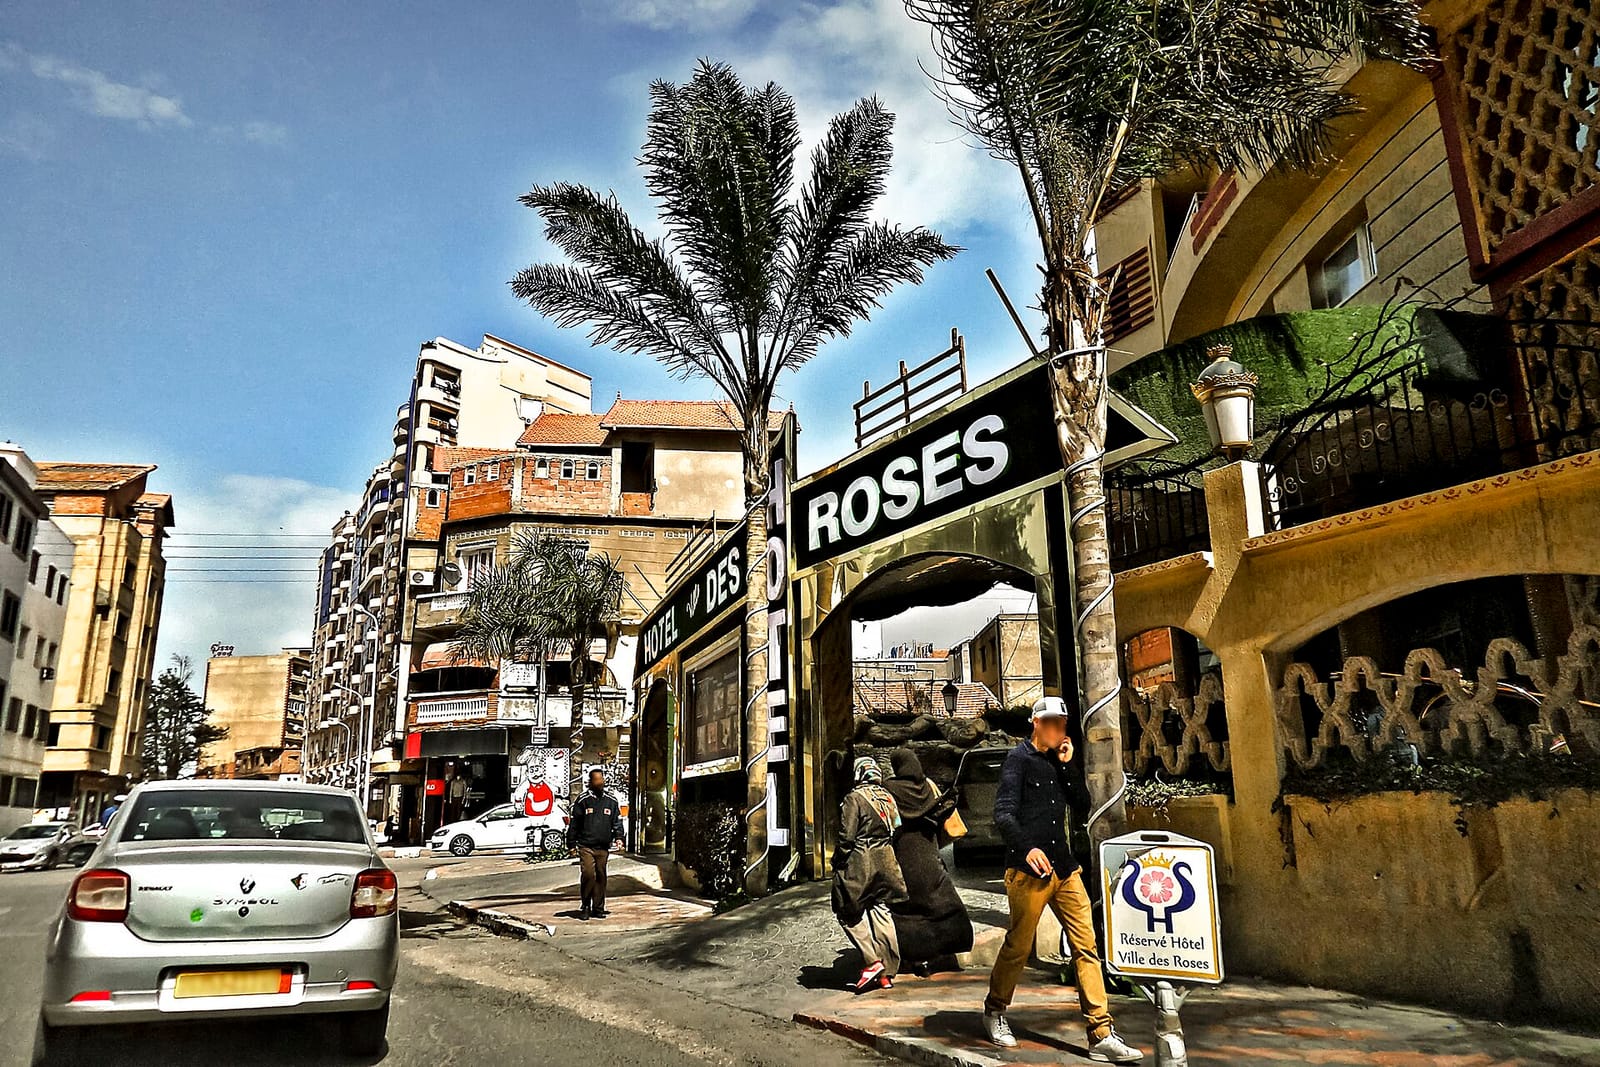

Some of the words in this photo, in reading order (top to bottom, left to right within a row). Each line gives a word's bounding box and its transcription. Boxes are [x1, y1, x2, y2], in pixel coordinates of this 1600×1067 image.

[808, 414, 1008, 551] ROSES
[644, 605, 678, 664] HOTEL
[706, 546, 740, 614] DES
[1118, 951, 1145, 965] Ville
[1149, 952, 1170, 967] des
[1173, 955, 1209, 970] Roses
[1120, 933, 1167, 948] Réservé
[1171, 936, 1205, 950] Hôtel
